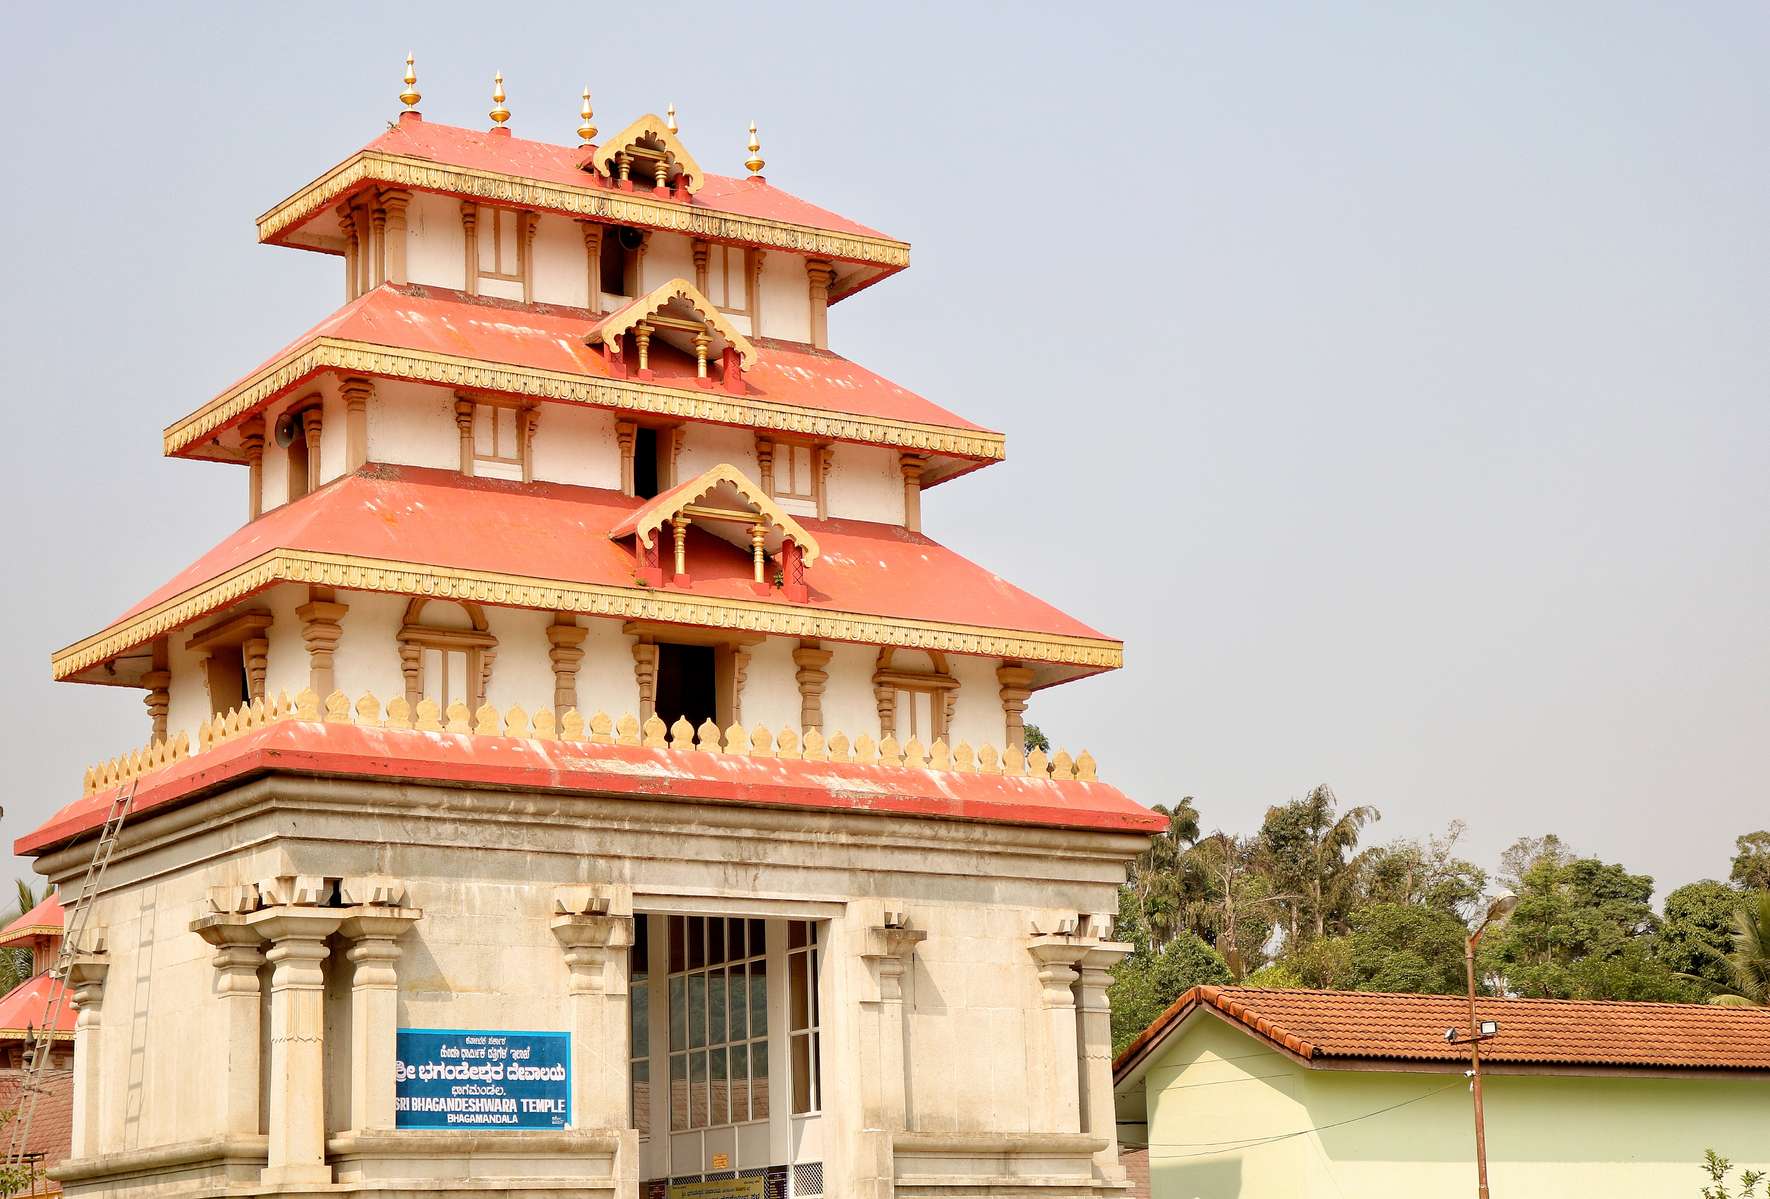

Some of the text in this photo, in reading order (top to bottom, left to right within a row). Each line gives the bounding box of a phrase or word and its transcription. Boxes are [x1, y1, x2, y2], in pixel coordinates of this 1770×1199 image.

[419, 1061, 504, 1083] ಭಗಂಡೇಶ್ವರ
[507, 1062, 566, 1081] ದೇವಾಲಯ
[396, 1097, 566, 1113] SRI BHAGANDESHWARA TEMPLE
[447, 1114, 519, 1124] BHAGAMANDALA
